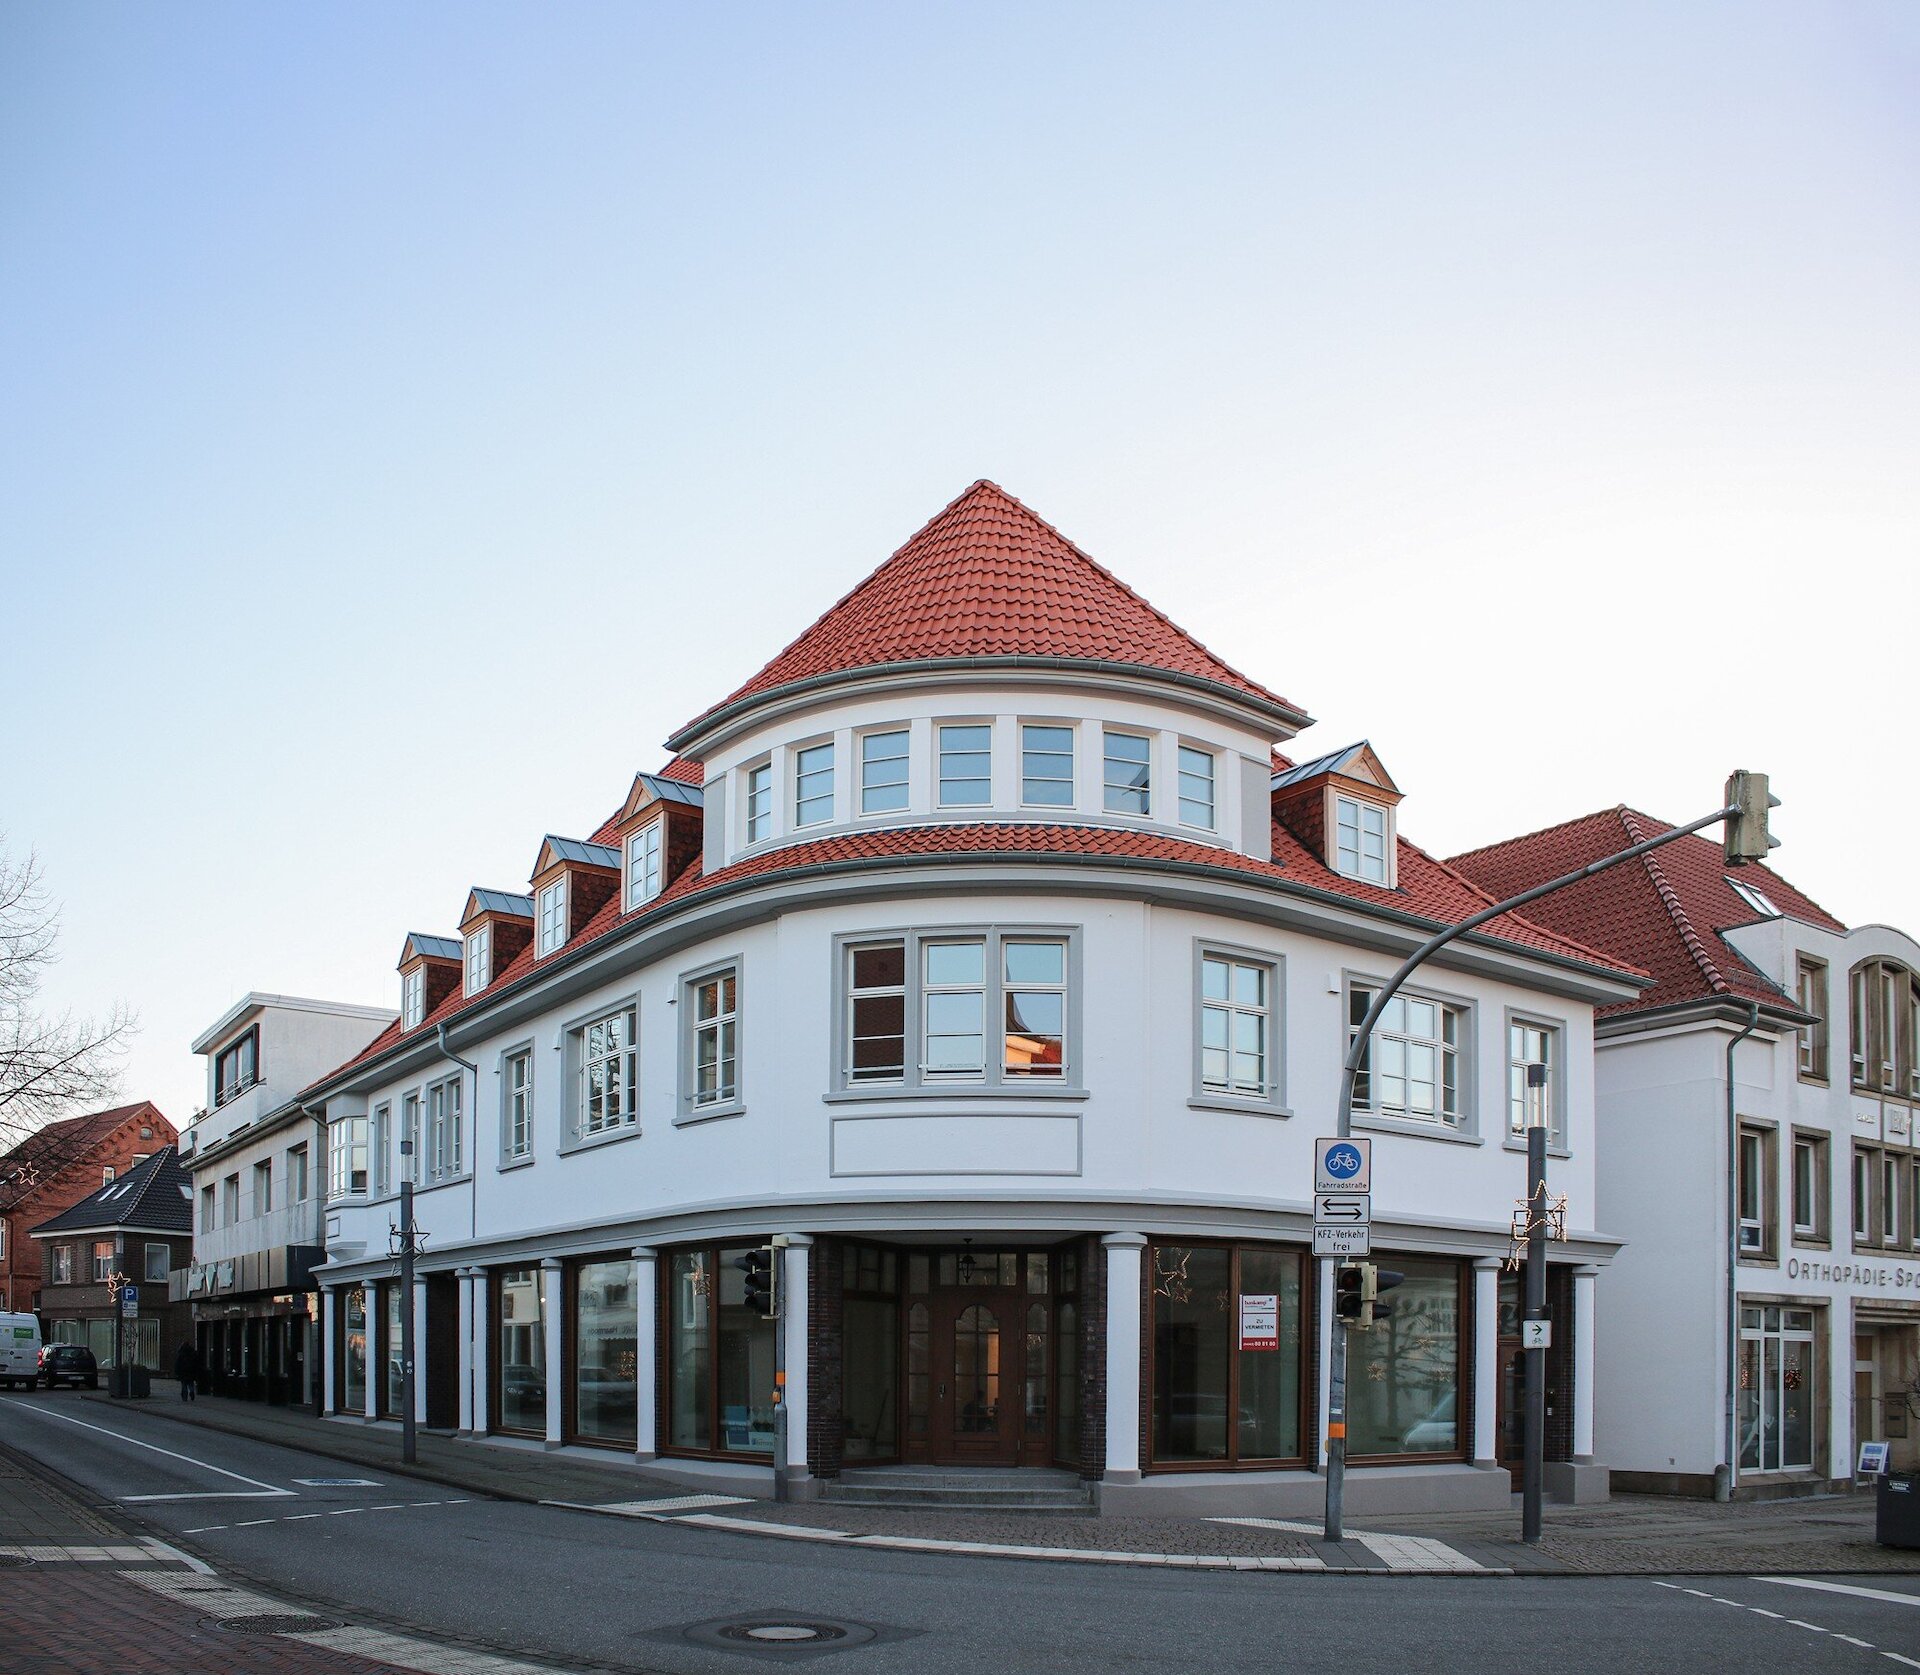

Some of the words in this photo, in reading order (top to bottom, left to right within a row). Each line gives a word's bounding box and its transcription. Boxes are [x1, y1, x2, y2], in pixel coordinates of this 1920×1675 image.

[1317, 1230, 1365, 1239] KFZ-Verkehr
[1333, 1242, 1350, 1251] frei
[125, 1288, 135, 1300] P
